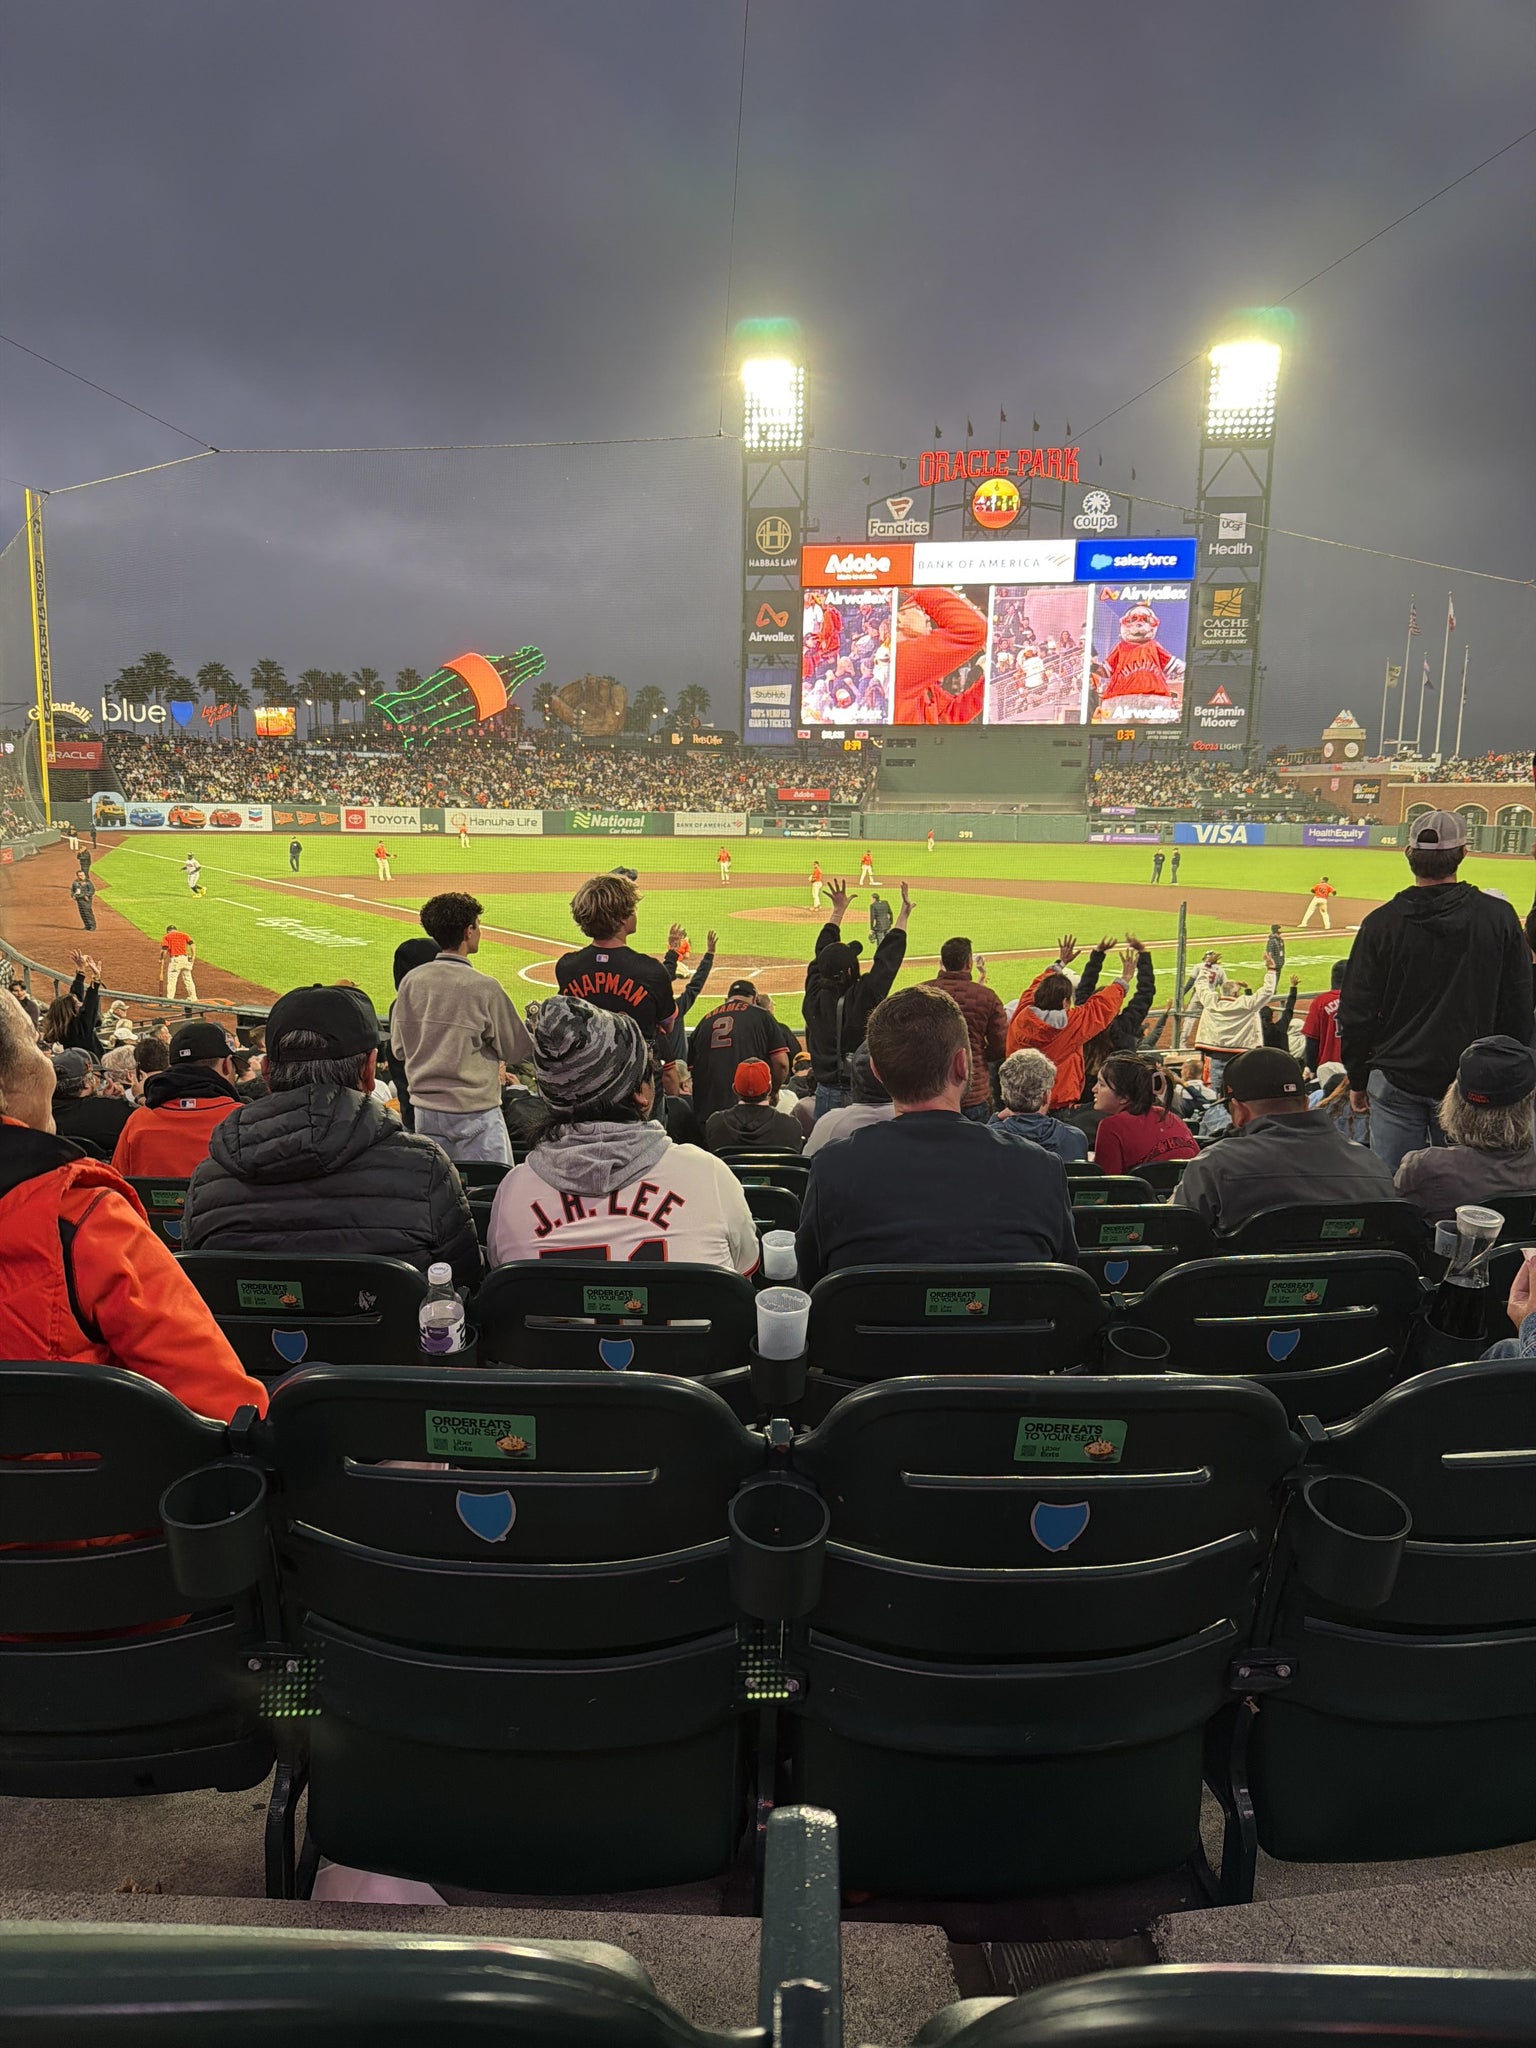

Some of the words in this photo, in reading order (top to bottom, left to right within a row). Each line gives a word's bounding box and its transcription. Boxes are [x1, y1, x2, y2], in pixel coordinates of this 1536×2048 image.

[919, 450, 1010, 487] ORACLE
[1017, 447, 1080, 483] PARK
[869, 518, 929, 536] Fanatics
[1075, 514, 1116, 530] coupa
[1208, 543, 1253, 556] Health
[749, 558, 779, 567] HABBAS
[780, 558, 798, 567] LAW
[824, 553, 891, 574] Adobe
[918, 560, 954, 570] BANK
[958, 559, 975, 569] OF
[979, 558, 1040, 568] AMERICA
[1113, 553, 1178, 568] salesforce
[1119, 586, 1188, 601] Airwallex
[1203, 619, 1249, 629] CACHE
[749, 632, 795, 643] Airwallex
[1203, 629, 1246, 638] CREEK
[755, 690, 786, 699] StubHub
[101, 697, 167, 724] blue
[1194, 706, 1245, 719] Benjamin
[1201, 717, 1238, 728] Moore
[1192, 741, 1219, 751] Coors
[370, 815, 417, 825] TOYOTA
[469, 817, 514, 826] Hanwha
[516, 818, 538, 827] Life
[591, 815, 645, 827] National
[1192, 825, 1247, 844] VISA
[1308, 828, 1366, 839] HealthEquity
[710, 1016, 734, 1048] 2
[608, 1181, 685, 1231] LEE
[1271, 1282, 1296, 1290] ORDER
[586, 1289, 613, 1297] ORDER
[432, 1416, 477, 1428] ORDER
[479, 1420, 511, 1430] EATS
[1024, 1423, 1070, 1434] ORDER
[1071, 1424, 1103, 1434] EATS
[434, 1425, 449, 1434] TO
[452, 1427, 480, 1436] YOUR
[484, 1429, 511, 1437] SEAT
[1042, 1433, 1072, 1442] YOUR
[1073, 1434, 1102, 1442] SEAT
